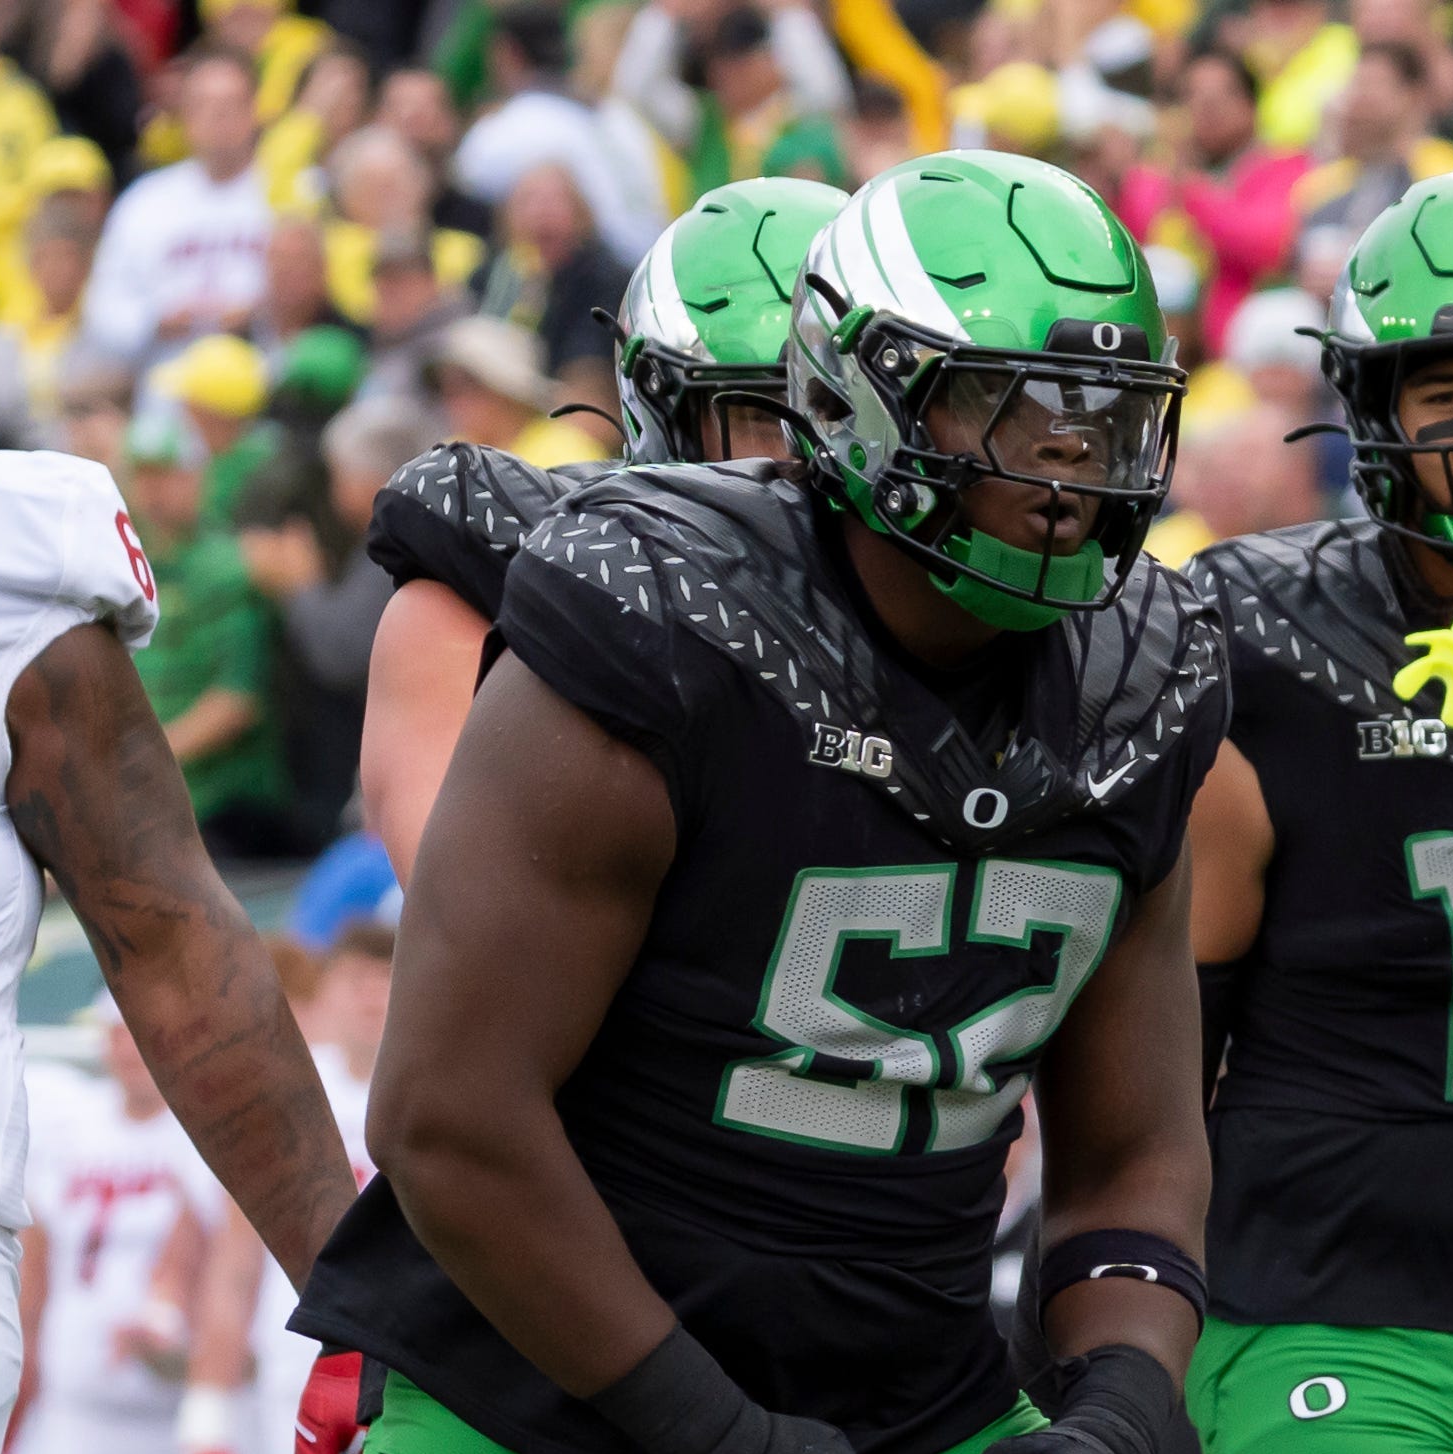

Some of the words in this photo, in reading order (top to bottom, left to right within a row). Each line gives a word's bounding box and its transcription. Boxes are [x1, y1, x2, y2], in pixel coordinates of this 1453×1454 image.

[962, 787, 1010, 830] O
[712, 859, 1123, 1155] 52
[1288, 1375, 1348, 1422] O
